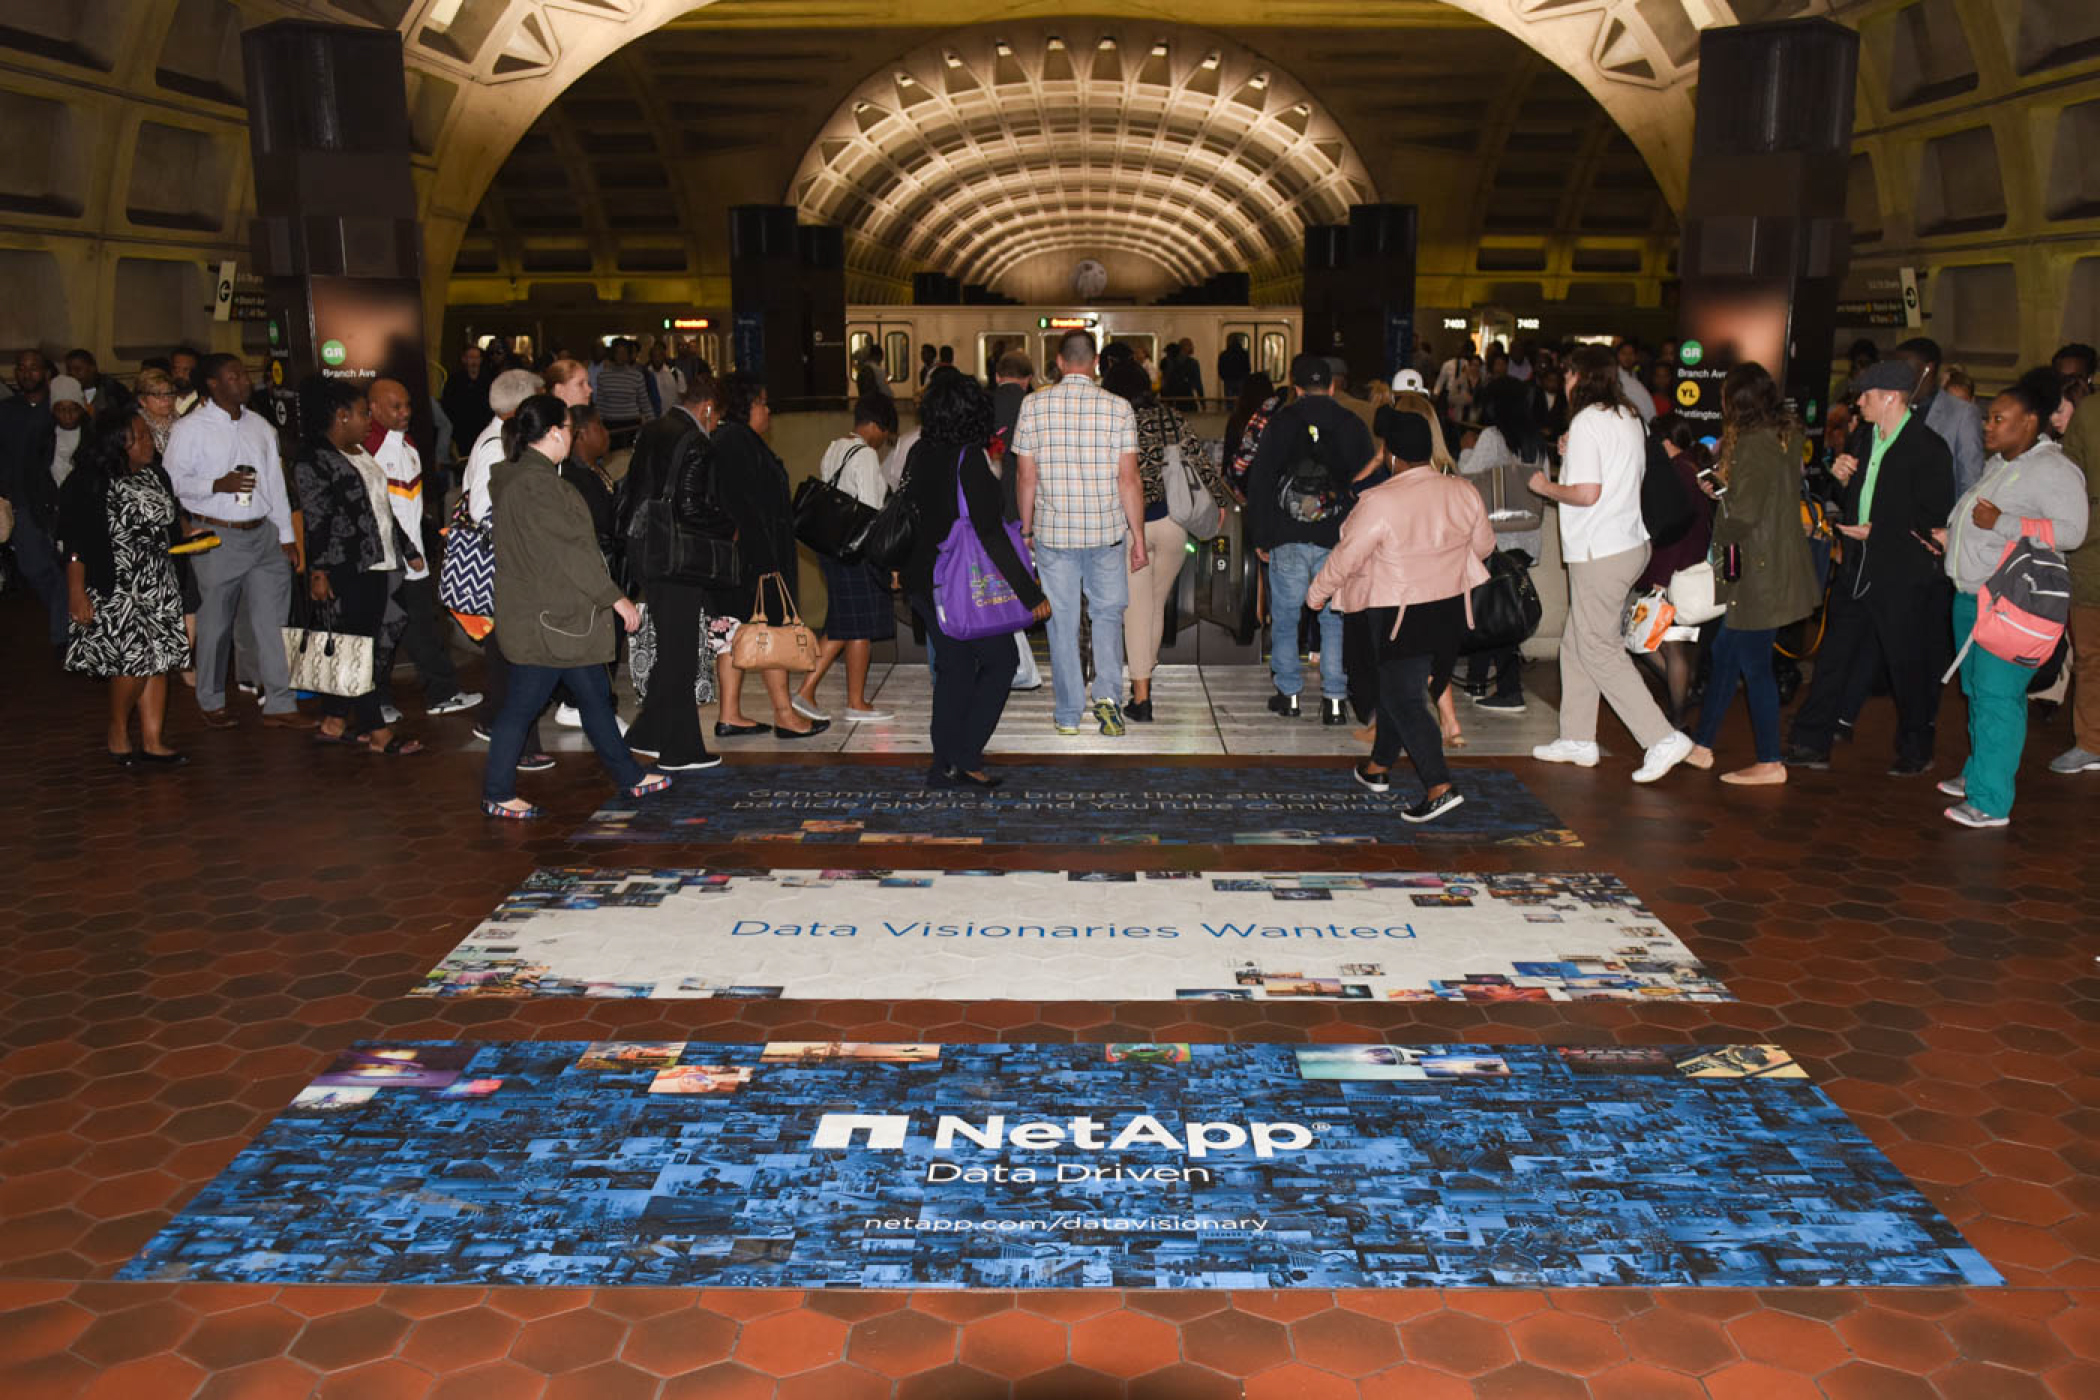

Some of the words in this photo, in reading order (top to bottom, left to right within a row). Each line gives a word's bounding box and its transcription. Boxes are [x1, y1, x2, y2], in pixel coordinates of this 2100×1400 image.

[324, 347, 343, 358] GR
[1682, 347, 1702, 358] GR
[1677, 368, 1709, 379] Branch
[1681, 389, 1696, 399] YL
[748, 788, 892, 799] Genomic
[905, 788, 976, 799] data
[989, 789, 1012, 799] is
[1025, 789, 1129, 801] bigger
[1143, 790, 1213, 800] than
[732, 799, 859, 810] particle
[1014, 799, 1075, 810] and
[1090, 800, 1234, 810] YouTube
[731, 919, 858, 937] Data
[882, 920, 1180, 938] Visionaries
[1200, 922, 1417, 939] Wanted
[926, 1162, 1036, 1184] Data
[1056, 1162, 1210, 1184] Driven
[863, 1215, 1269, 1233] netapp.com/datavisionary
